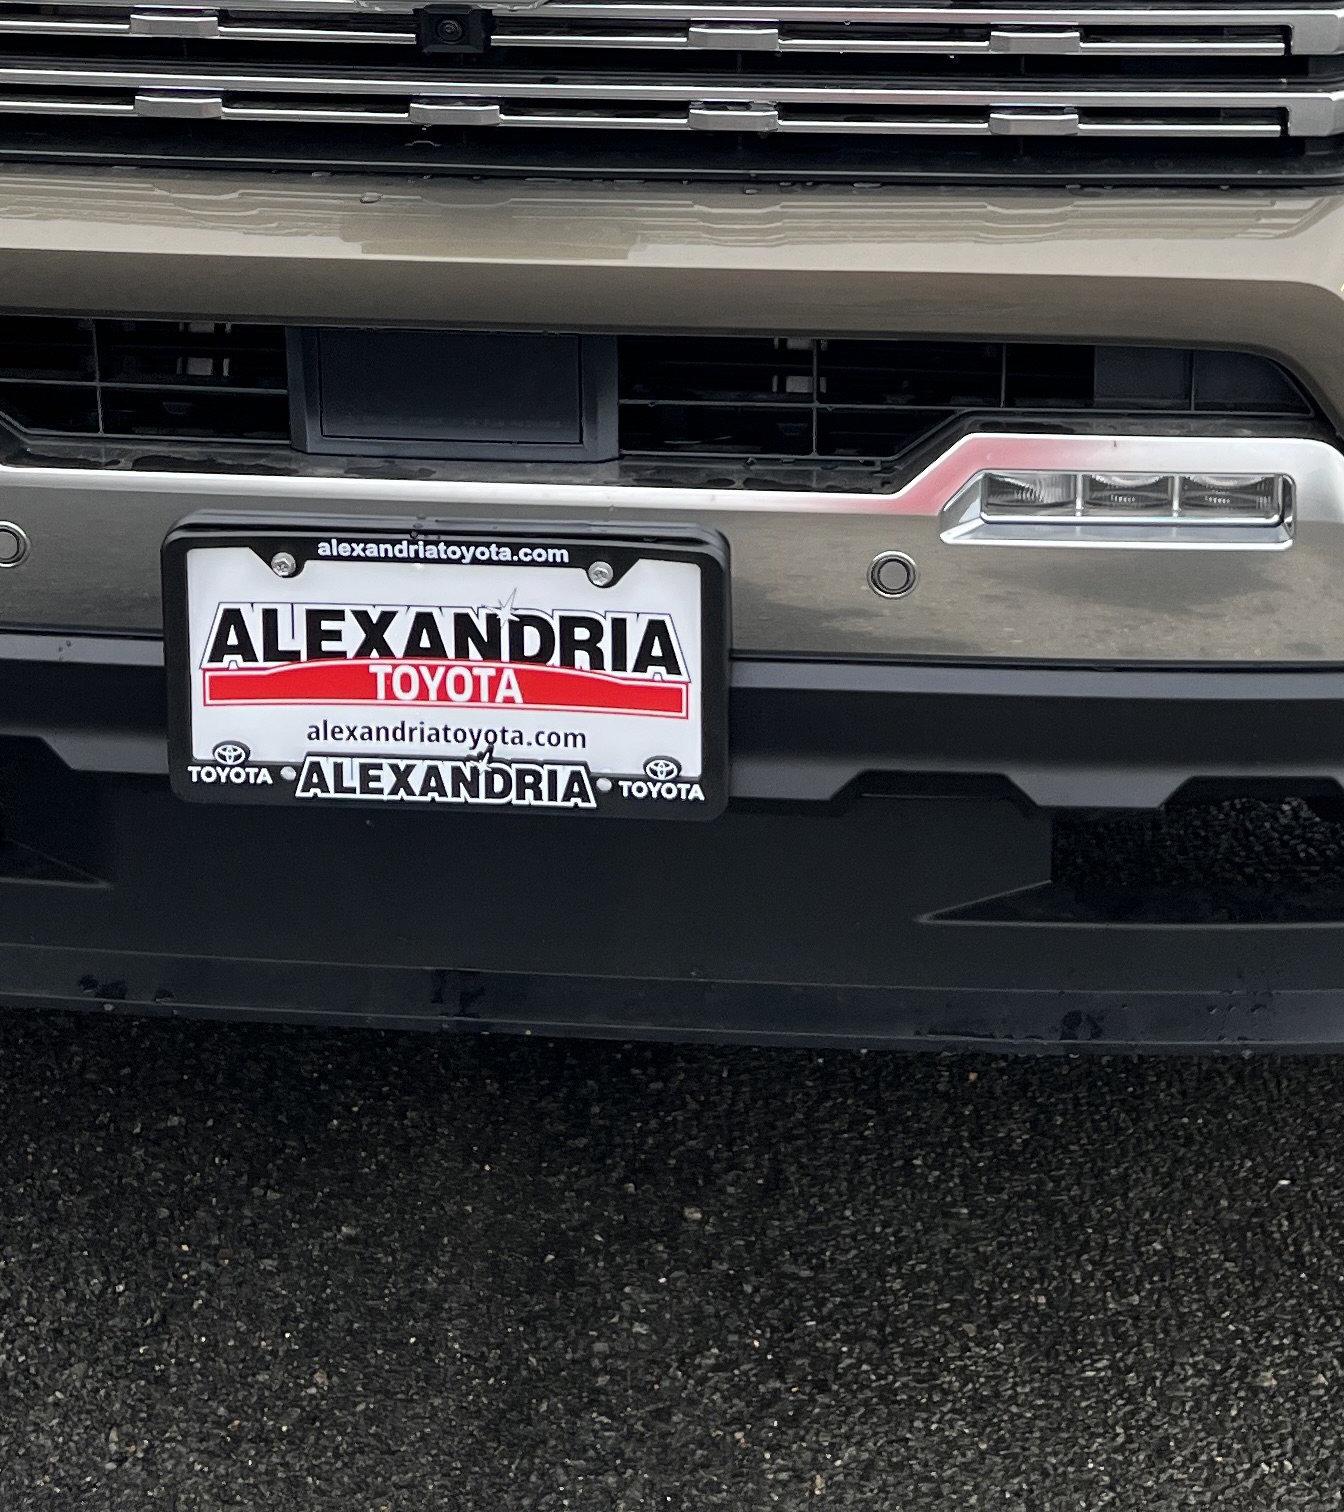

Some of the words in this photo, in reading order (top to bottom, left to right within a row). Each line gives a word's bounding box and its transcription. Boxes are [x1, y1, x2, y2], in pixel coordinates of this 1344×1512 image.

[317, 539, 570, 563] alexandriatoyota.com
[206, 603, 685, 678] ALEXANDRIA
[369, 664, 524, 704] TOYOTA
[307, 719, 587, 750] alexandriatoyota.com
[187, 765, 273, 785] TOYOTA
[297, 757, 595, 807] ALEXANDRIA
[618, 780, 705, 801] TOYOTA
